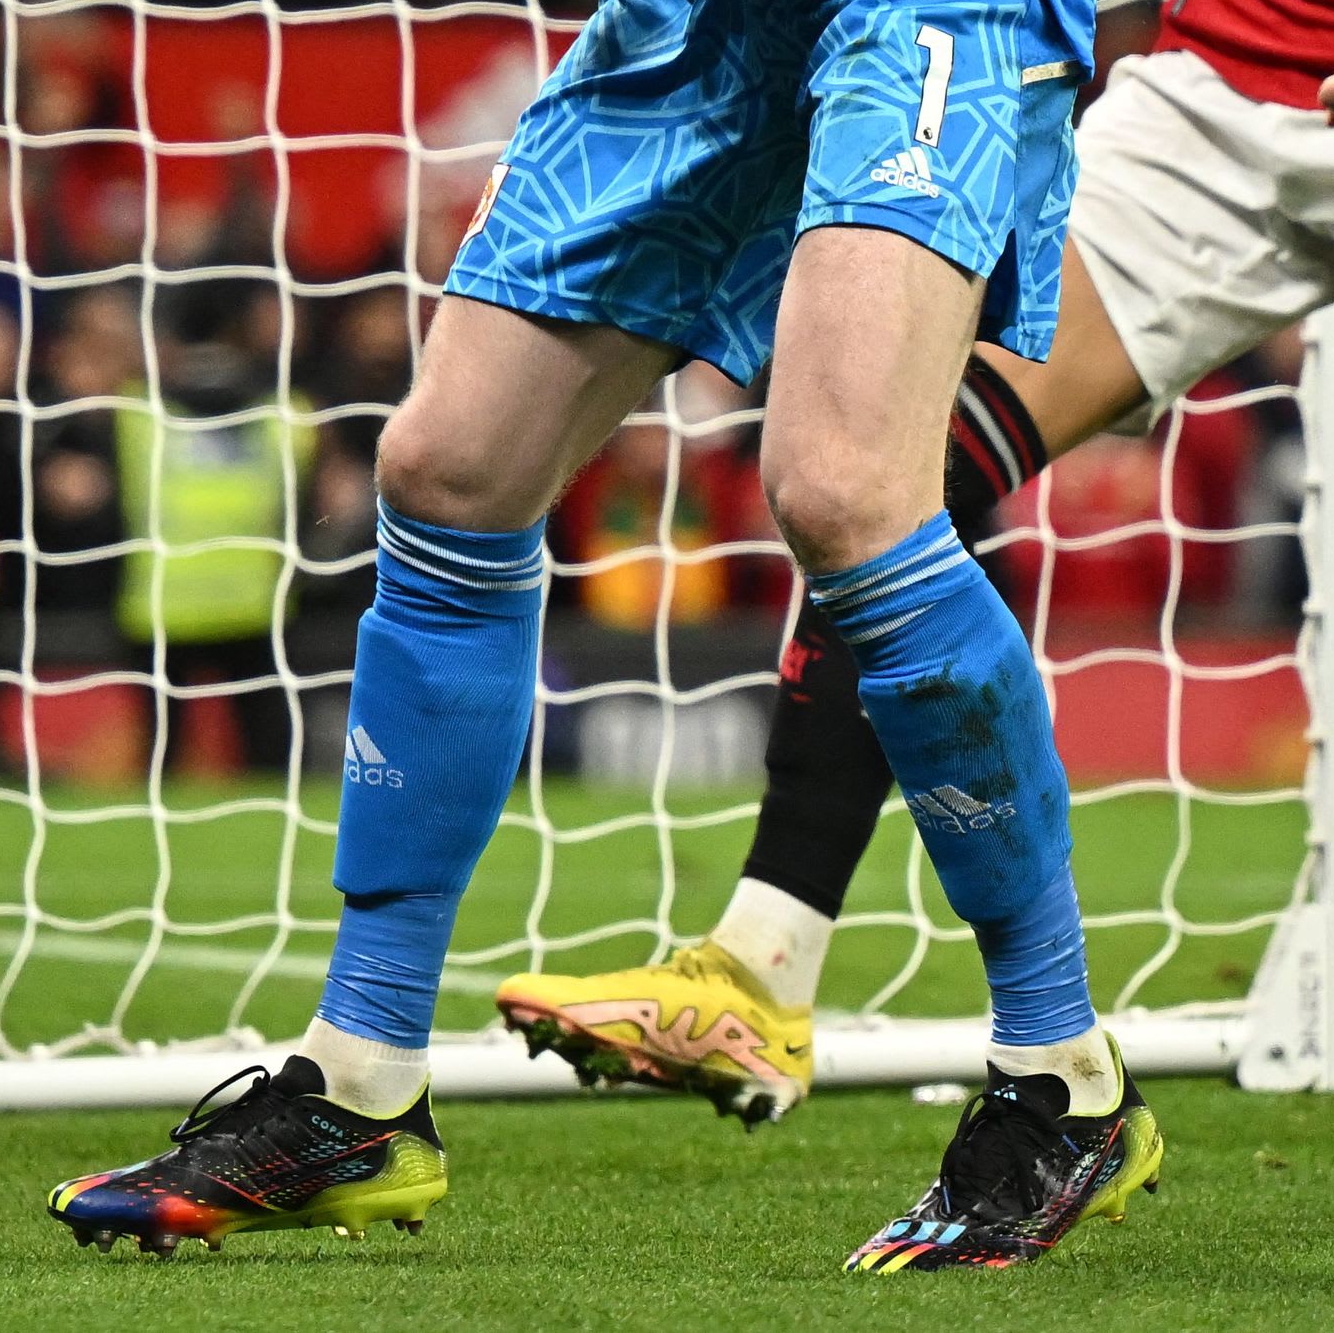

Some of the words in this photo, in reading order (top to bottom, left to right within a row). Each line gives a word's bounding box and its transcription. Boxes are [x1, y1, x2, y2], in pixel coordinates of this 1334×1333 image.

[914, 24, 955, 148] 1
[870, 166, 940, 199] adidas
[311, 1115, 344, 1139] COPA
